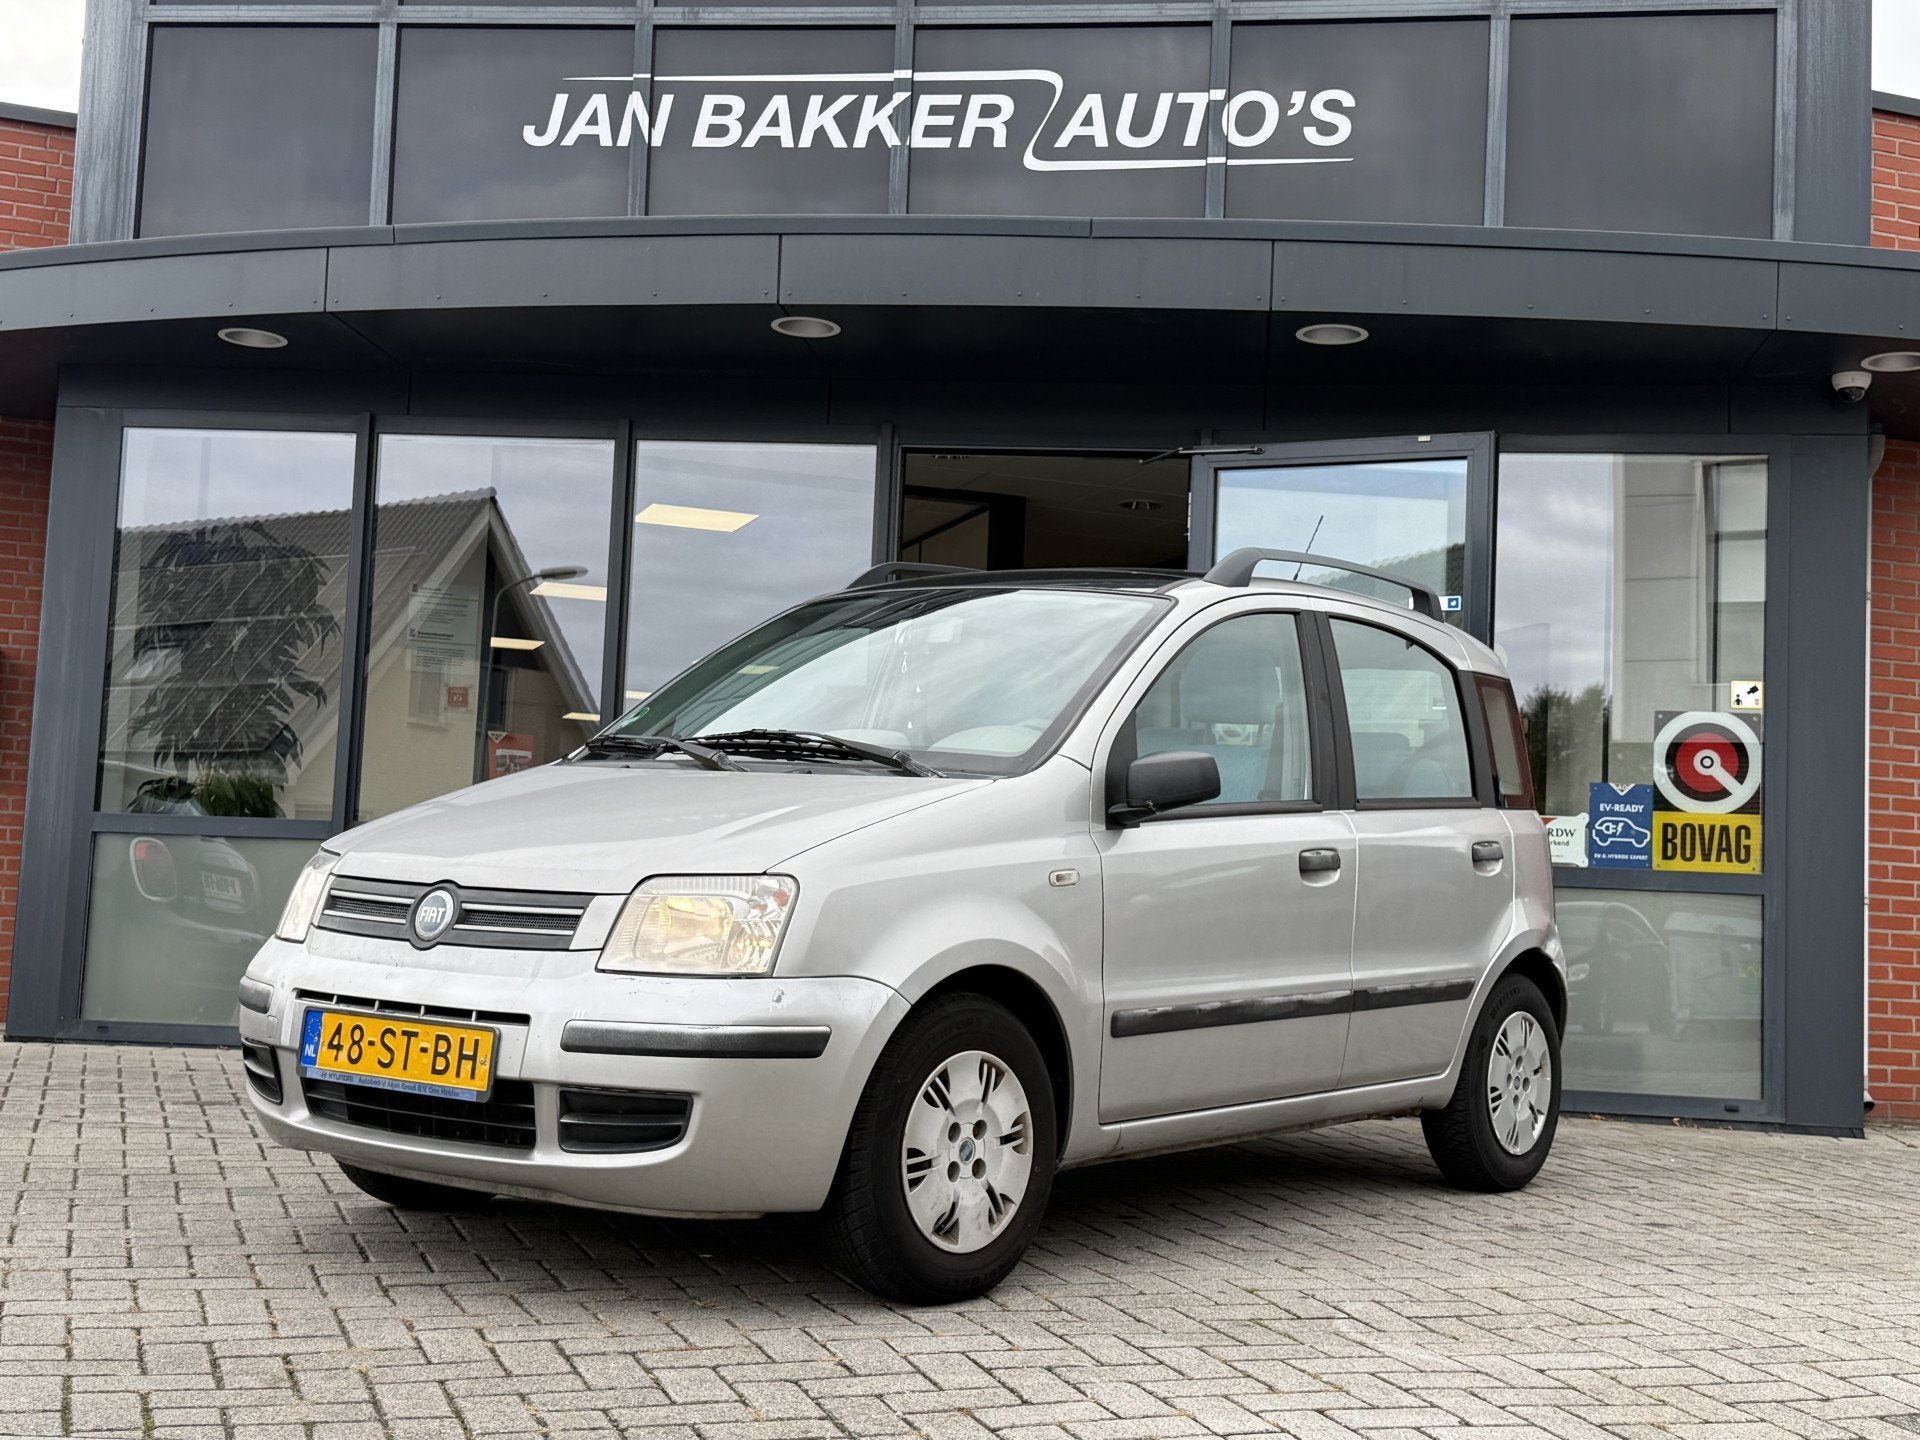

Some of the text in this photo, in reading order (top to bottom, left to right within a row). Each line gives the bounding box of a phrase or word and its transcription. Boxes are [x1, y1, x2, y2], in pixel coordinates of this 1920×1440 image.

[523, 89, 1355, 149] JAN BAKKER AUTO'S
[1599, 803, 1645, 813] EV-READY
[1547, 828, 1576, 837] RDW
[1661, 822, 1751, 864] BOVAG
[419, 906, 446, 923] FIAT
[304, 1043, 316, 1058] NL
[327, 1022, 480, 1080] 48-ST-BH
